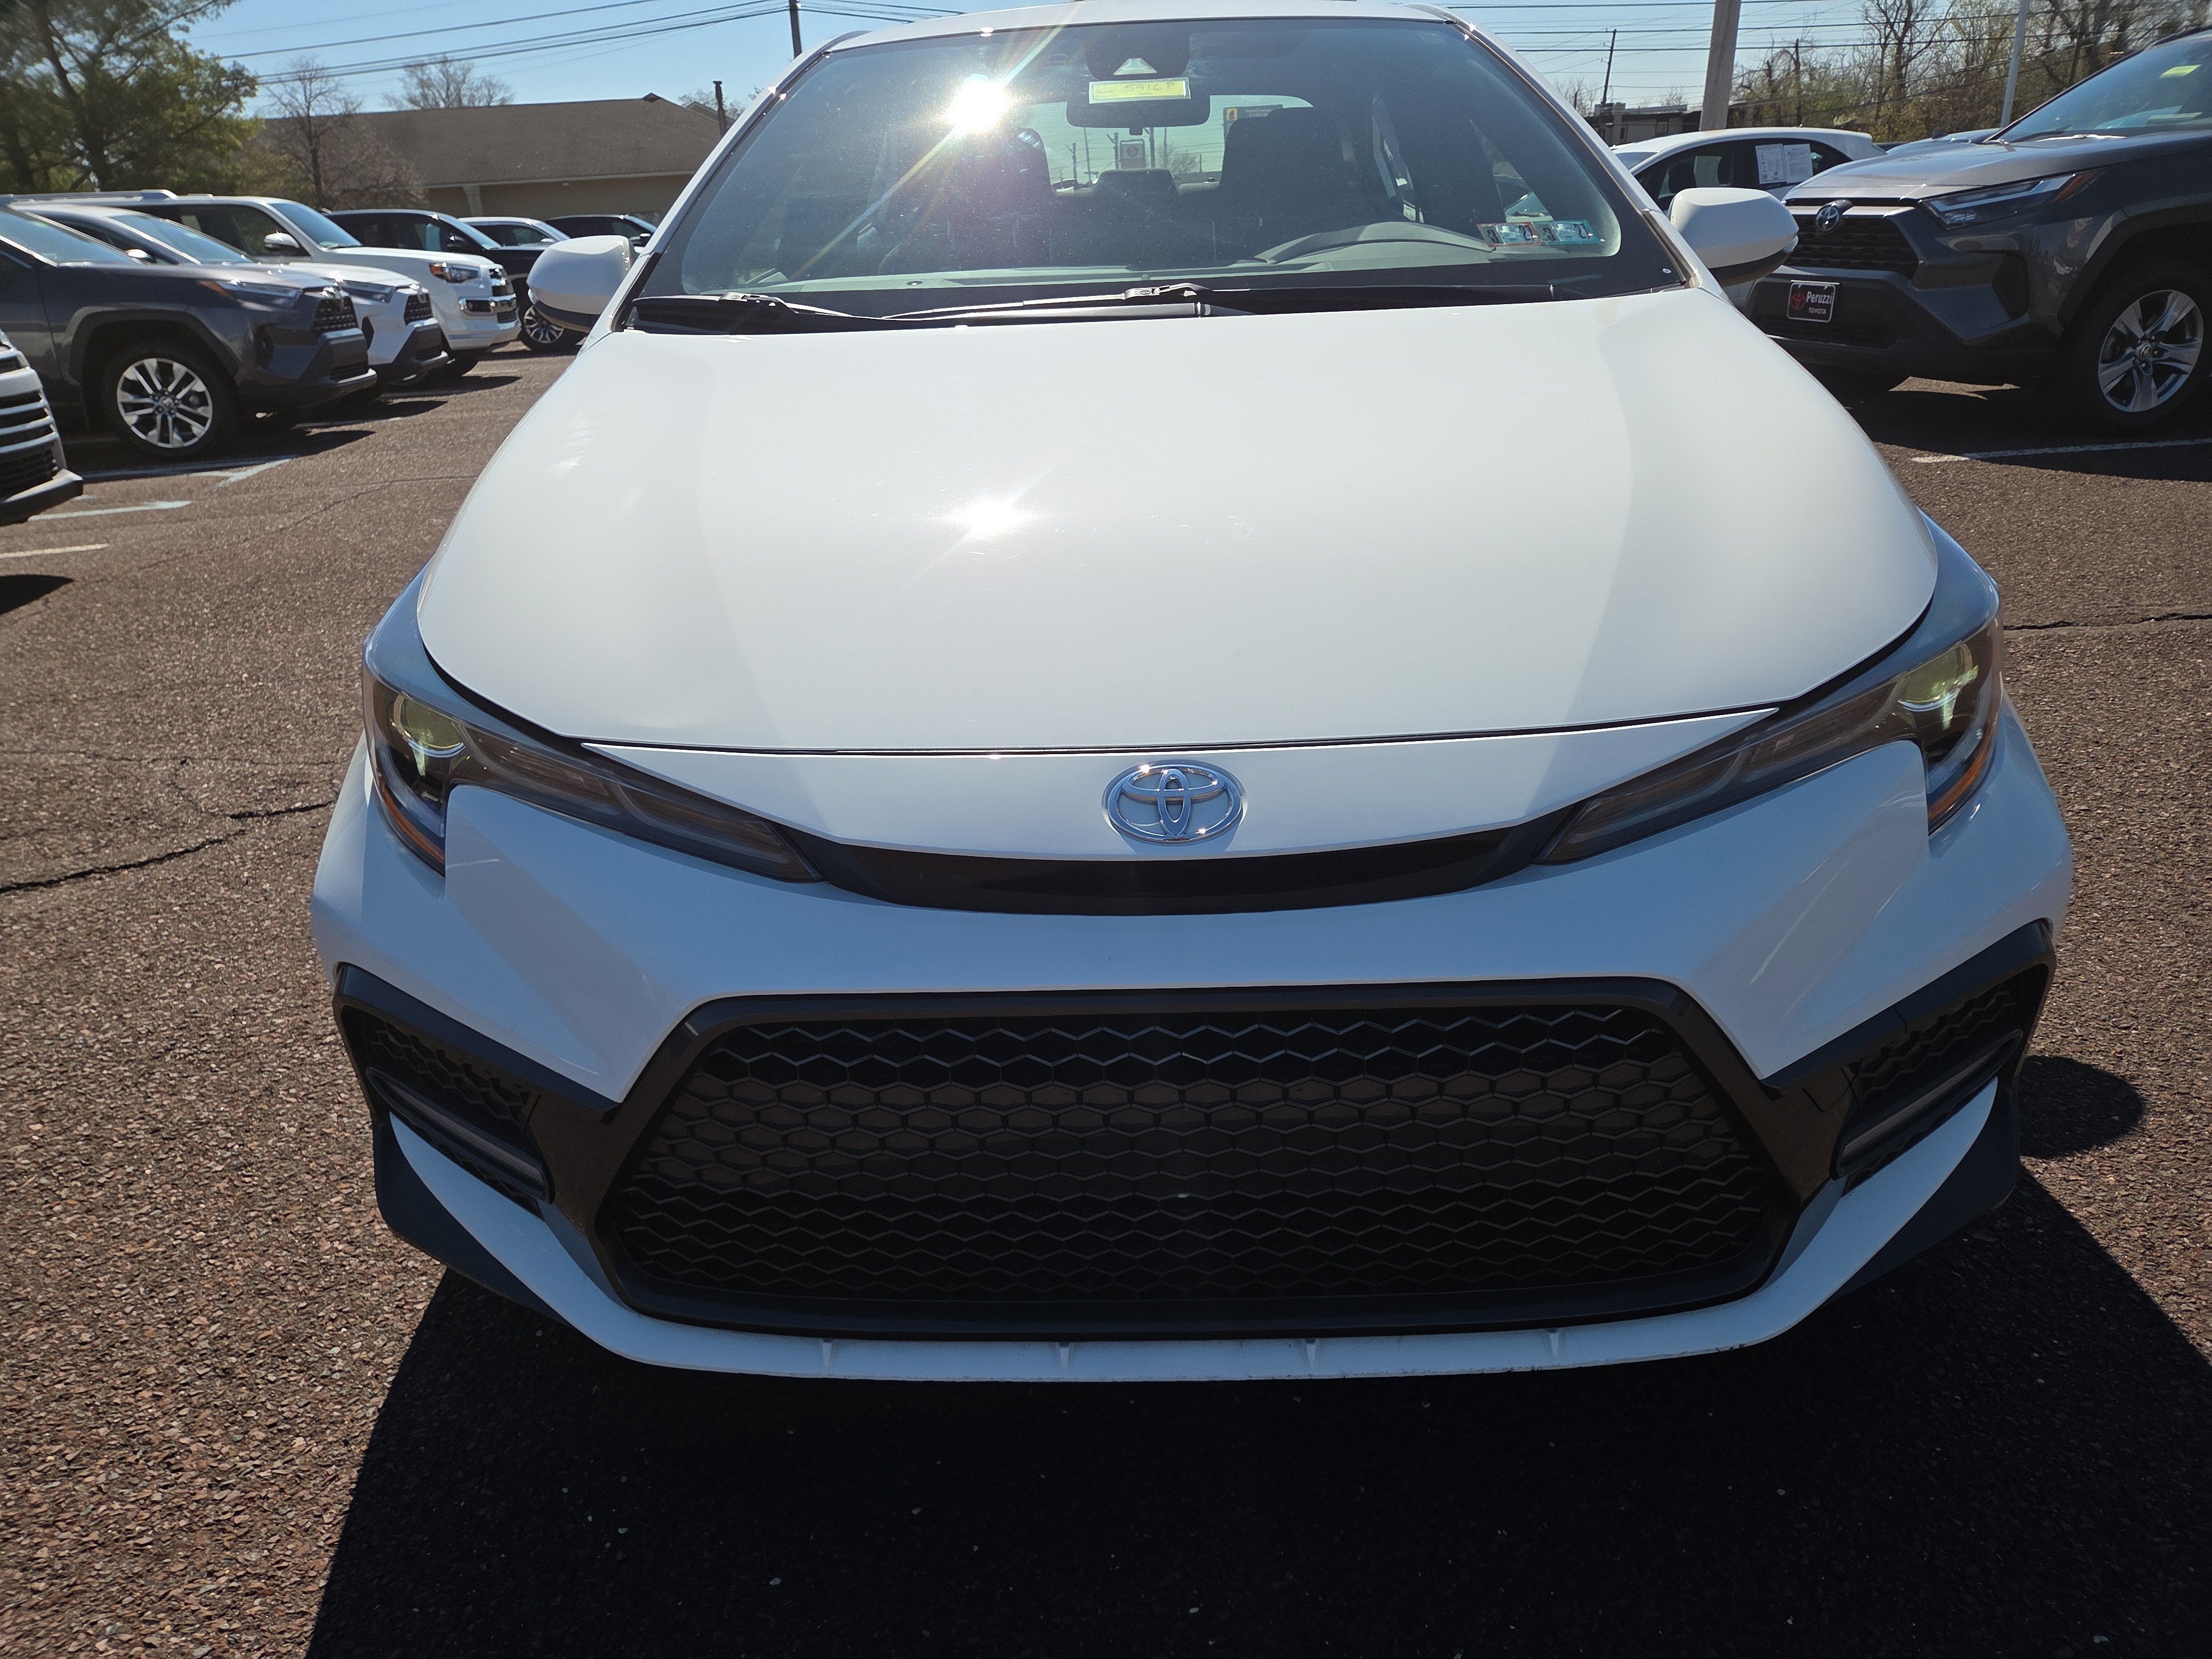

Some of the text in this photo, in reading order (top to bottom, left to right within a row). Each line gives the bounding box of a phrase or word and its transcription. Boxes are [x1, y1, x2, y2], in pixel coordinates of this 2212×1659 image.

[1487, 229, 1500, 243] 3
[1542, 227, 1557, 241] 3
[1806, 291, 1834, 304] Peruzzi
